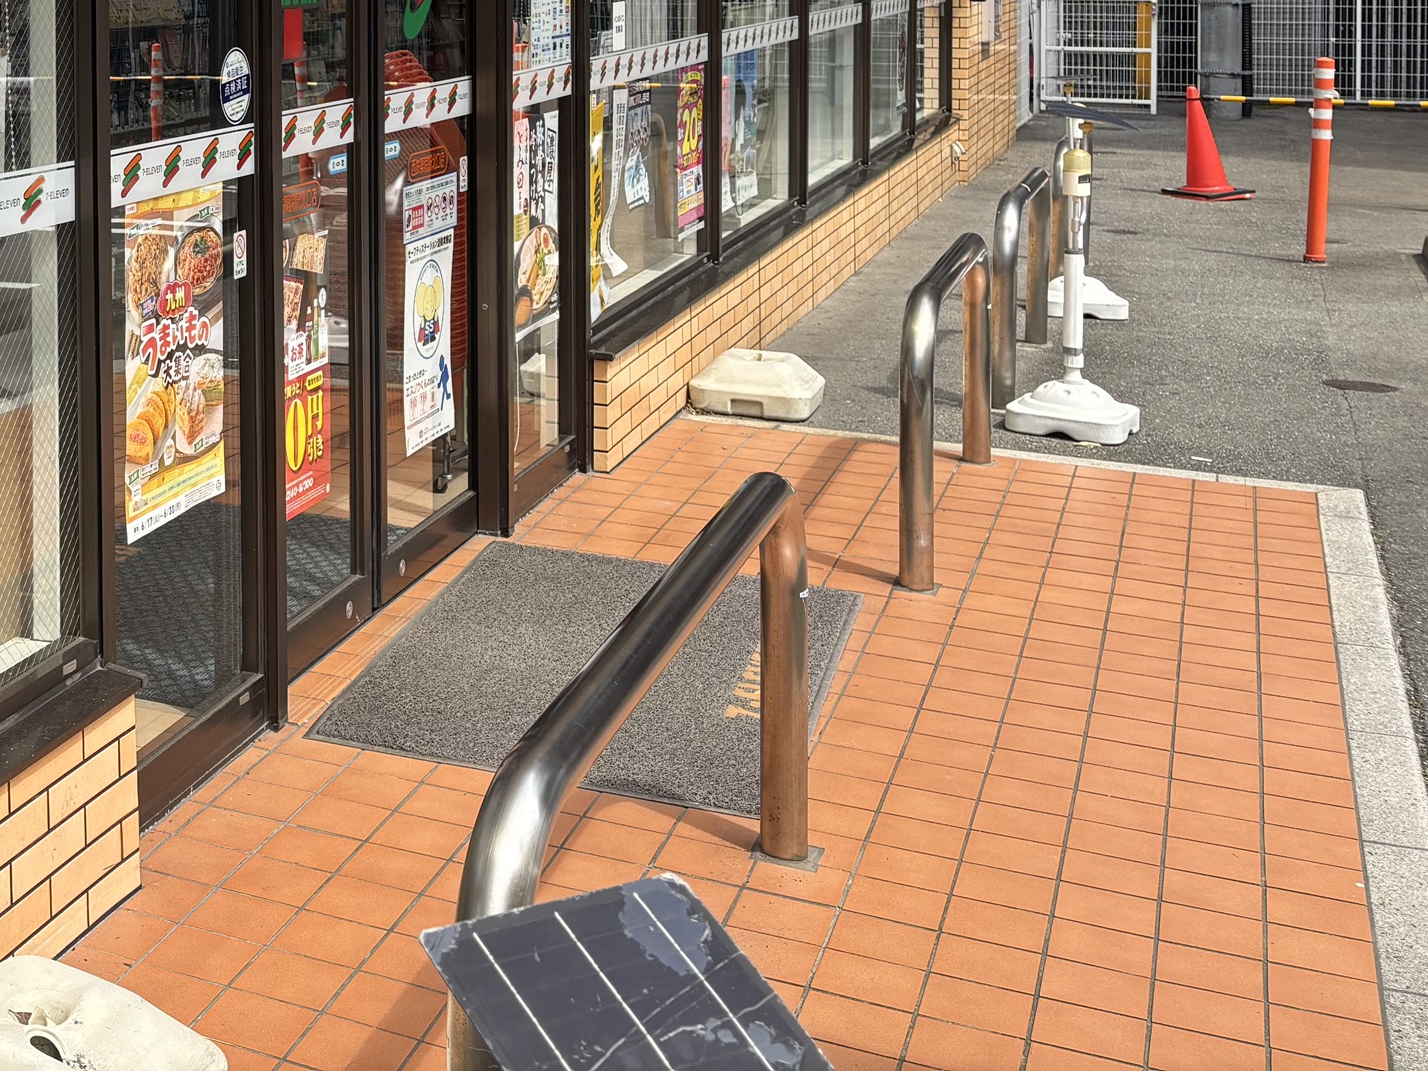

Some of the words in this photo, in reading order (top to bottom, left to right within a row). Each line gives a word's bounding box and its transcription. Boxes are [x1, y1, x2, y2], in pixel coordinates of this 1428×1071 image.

[165, 287, 186, 312] 九州
[424, 319, 434, 334] SS
[140, 307, 211, 374] うまいもの
